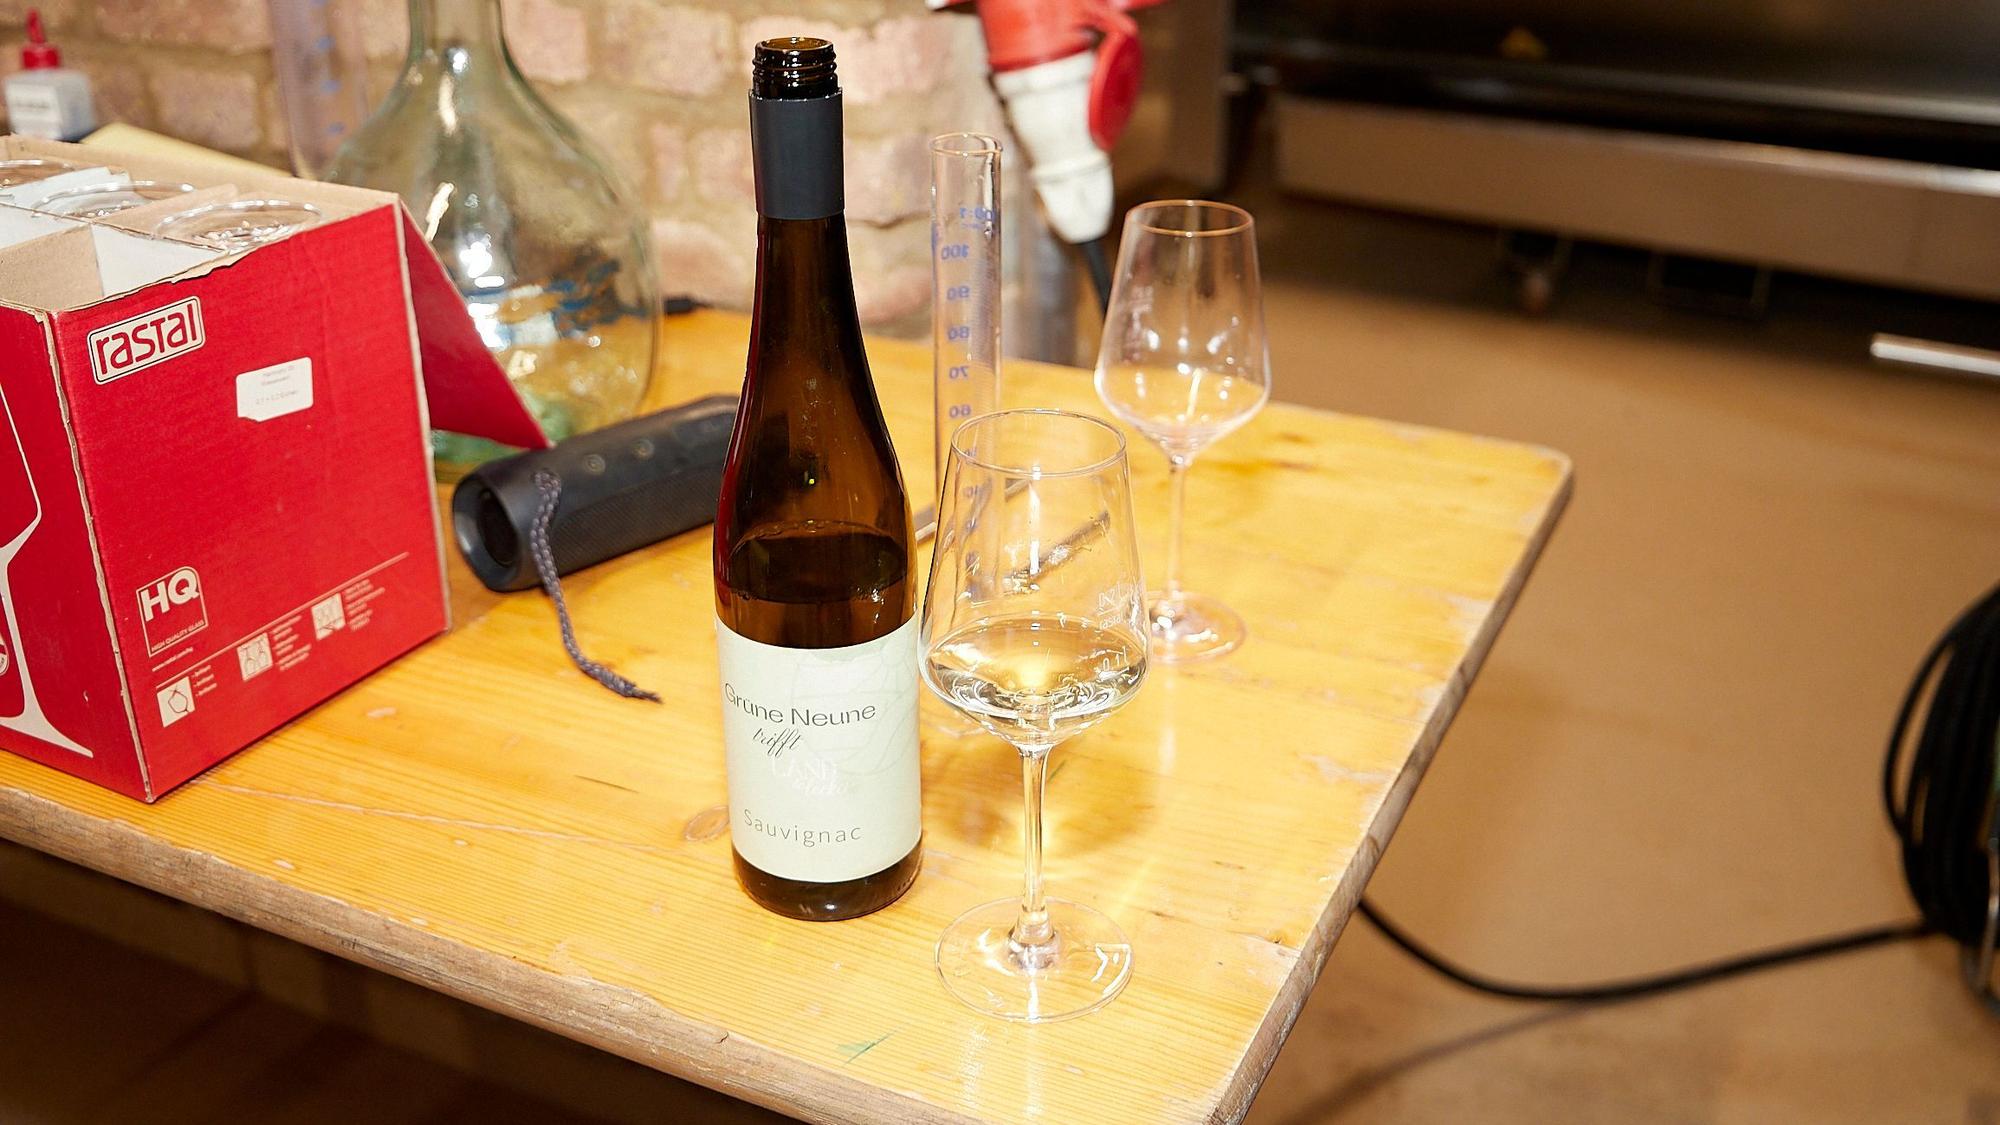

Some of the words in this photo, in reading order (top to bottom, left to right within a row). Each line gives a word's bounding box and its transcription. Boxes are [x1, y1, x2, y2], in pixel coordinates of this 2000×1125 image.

[95, 303, 198, 375] rastal
[140, 568, 200, 622] HQ
[150, 640, 166, 653] HIGH
[165, 628, 188, 644] QUALITY
[187, 619, 205, 632] GLASS
[724, 682, 784, 724] Grüne
[790, 704, 877, 727] Neune
[752, 727, 802, 758] trifft
[743, 808, 863, 848] Sauvignac
